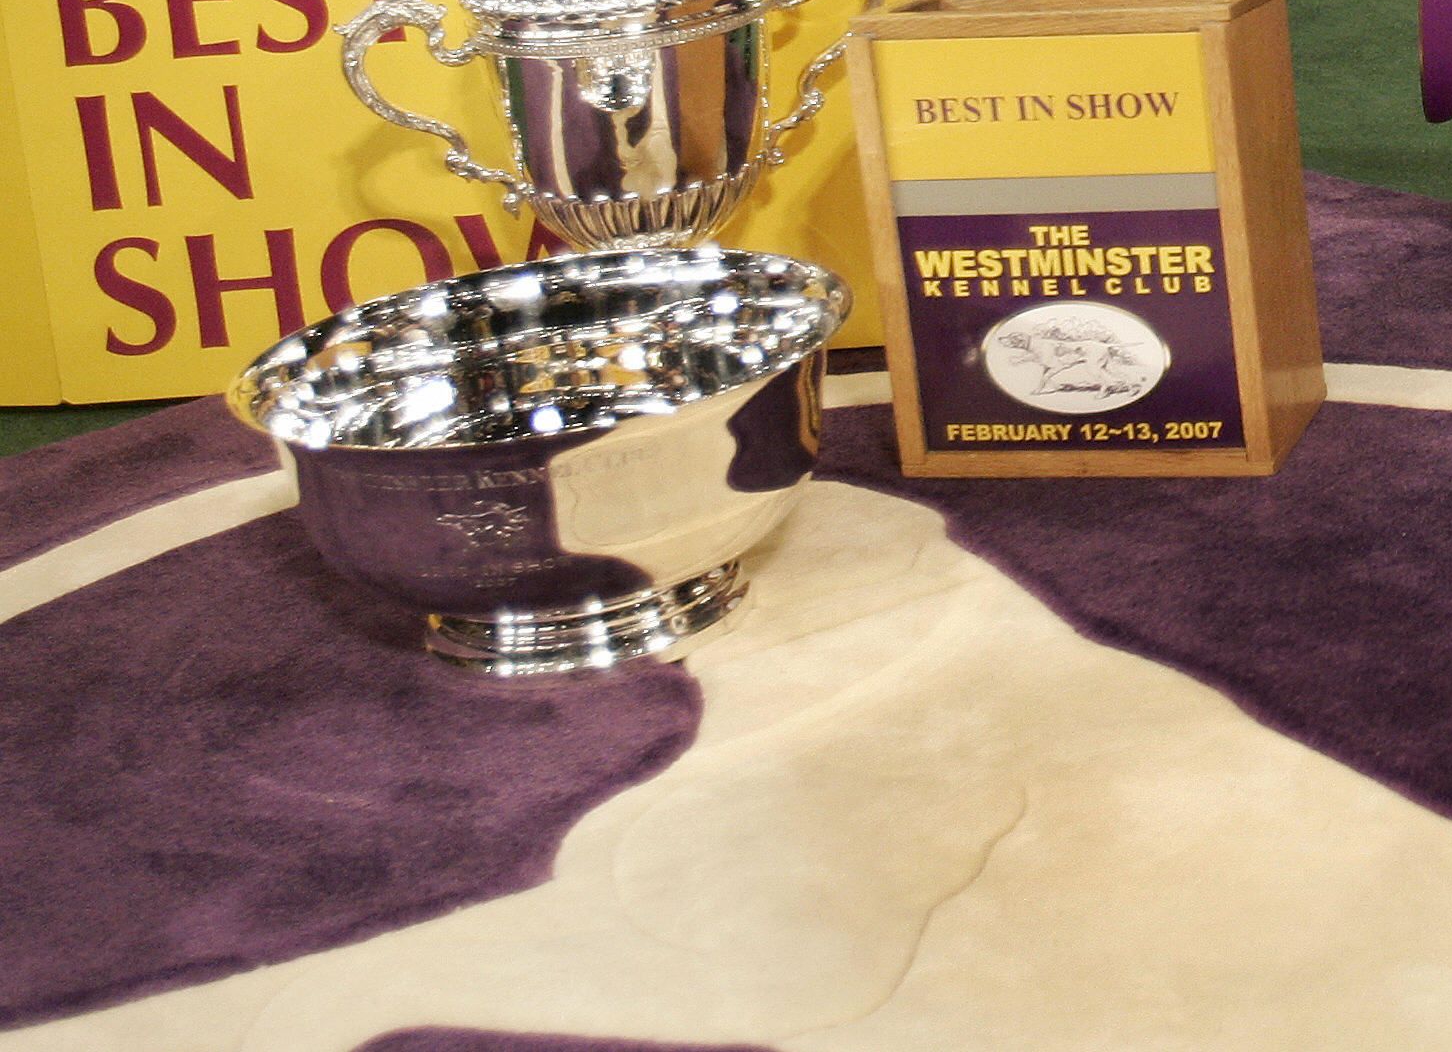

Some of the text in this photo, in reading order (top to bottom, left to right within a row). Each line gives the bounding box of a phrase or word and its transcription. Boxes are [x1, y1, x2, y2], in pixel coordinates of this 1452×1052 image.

[914, 92, 1179, 125] BEST IN SHOW
[75, 85, 254, 211] IN
[1029, 225, 1091, 247] THE
[914, 245, 1215, 279] WESTMINSTER
[923, 275, 1212, 297] KENNEL CLUB
[946, 423, 1072, 442] FEBRUARY
[1165, 421, 1224, 440] 2007
